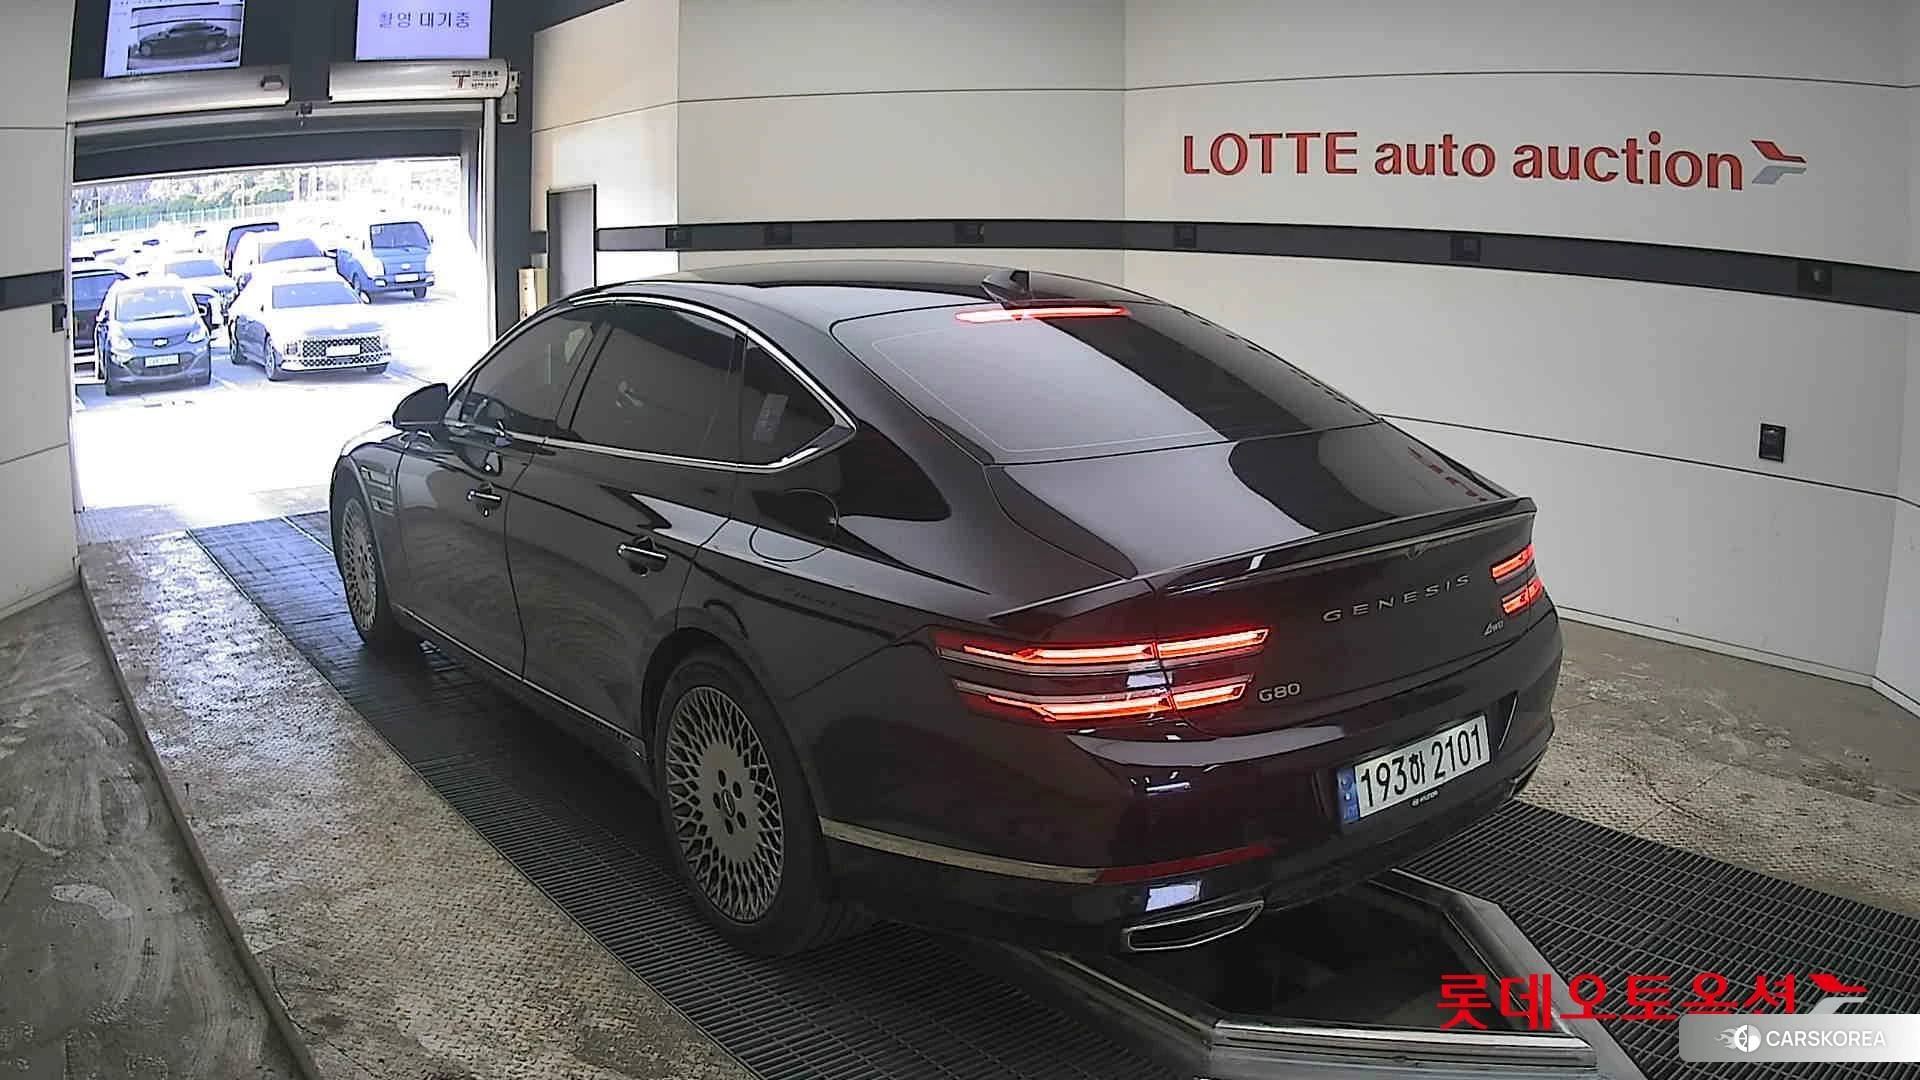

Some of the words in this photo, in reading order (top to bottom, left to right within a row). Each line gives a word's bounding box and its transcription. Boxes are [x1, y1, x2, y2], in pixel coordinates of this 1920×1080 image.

[420, 11, 471, 29] 대기중
[1184, 131, 1359, 176] LOTTE
[1375, 134, 1495, 177] auto
[1513, 131, 1744, 191] auction
[1323, 575, 1471, 622] GENESIS
[1258, 683, 1301, 702] G80
[1431, 723, 1483, 781] 2101
